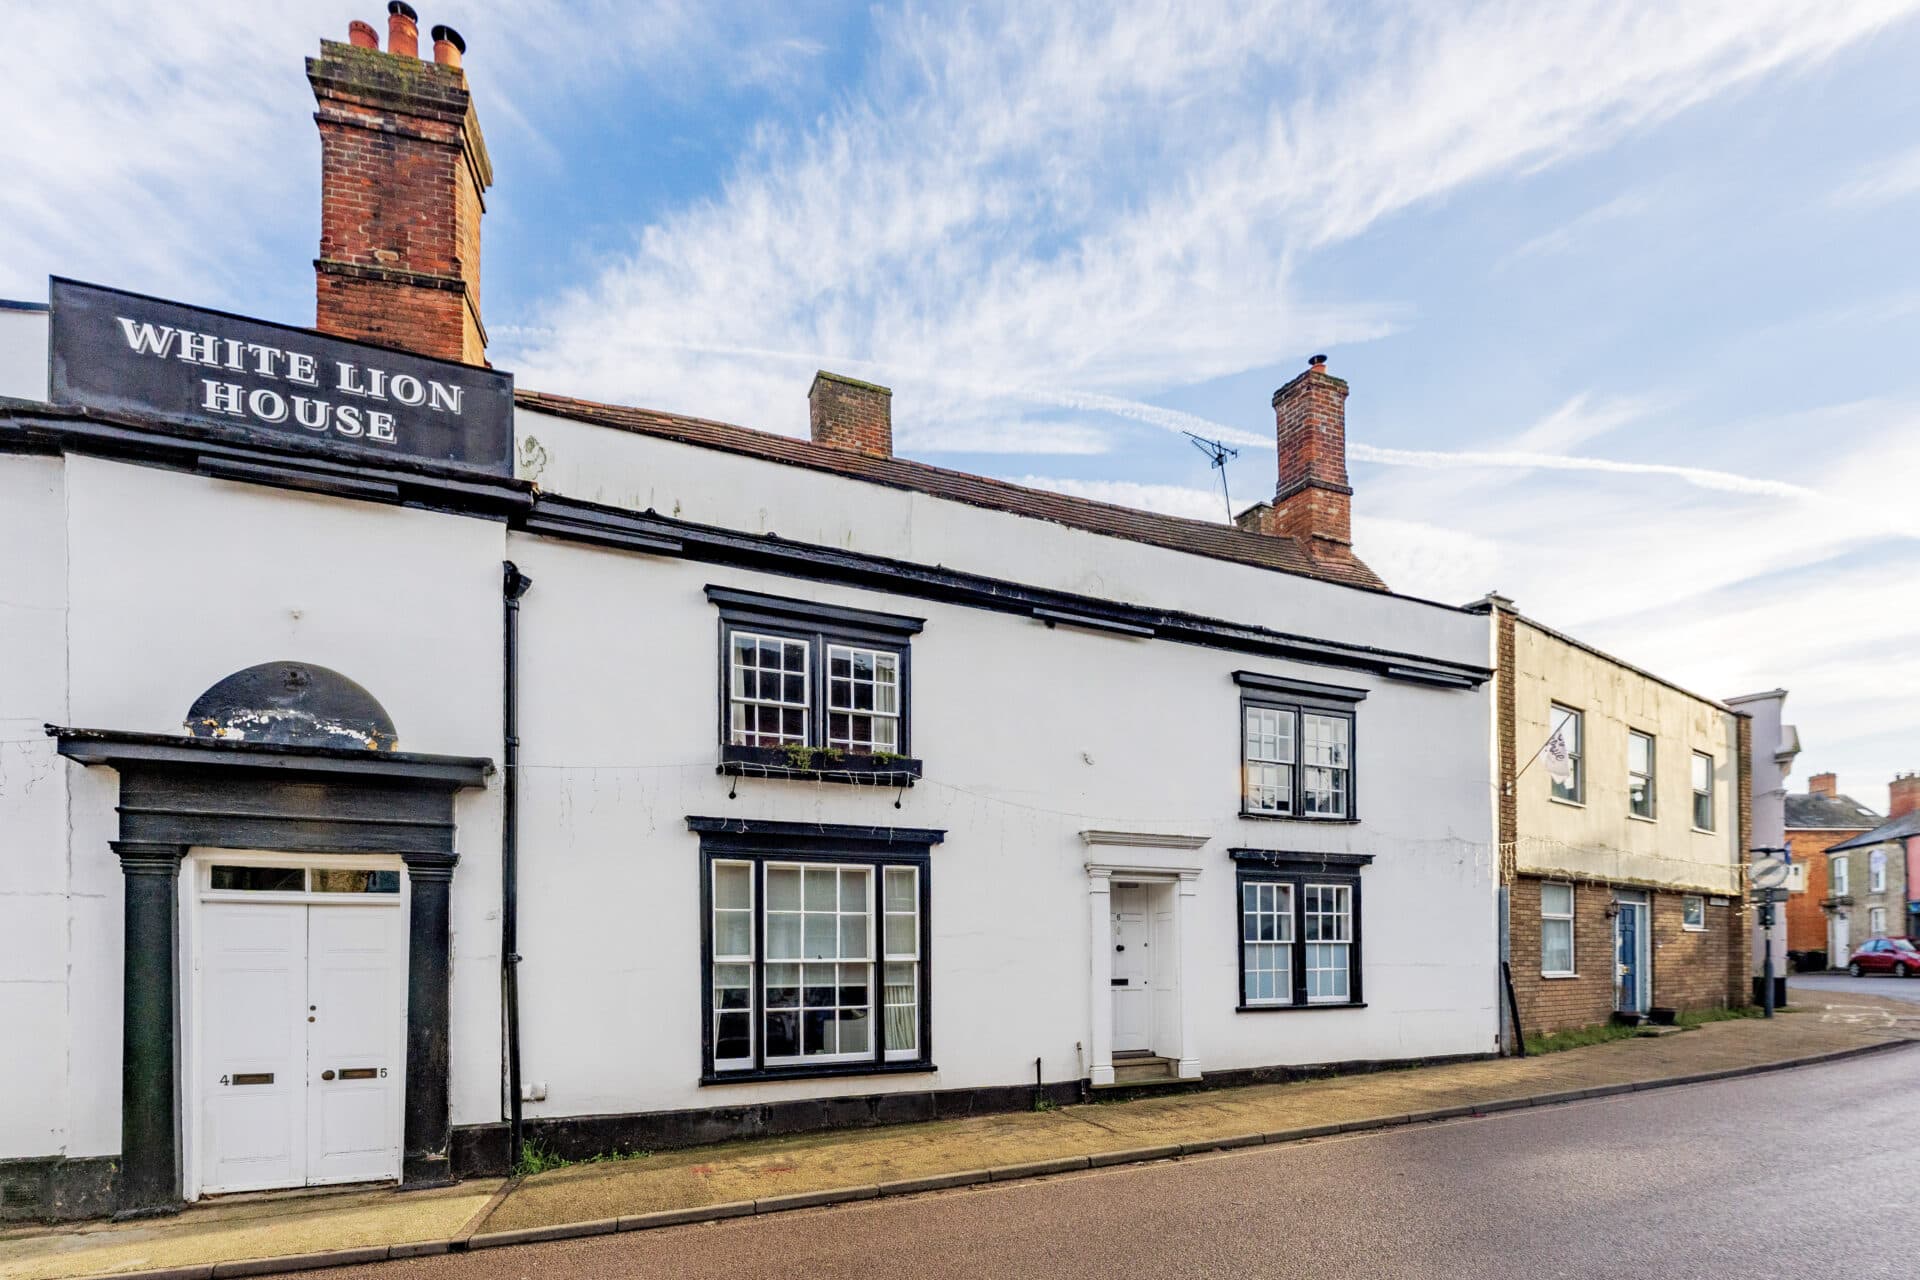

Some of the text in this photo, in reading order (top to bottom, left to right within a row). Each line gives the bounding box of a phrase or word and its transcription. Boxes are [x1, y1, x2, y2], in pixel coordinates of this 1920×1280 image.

[117, 316, 464, 415] WHITE LION
[201, 379, 397, 444] HOUSE
[219, 1074, 230, 1086] 4
[380, 1067, 388, 1079] 5
